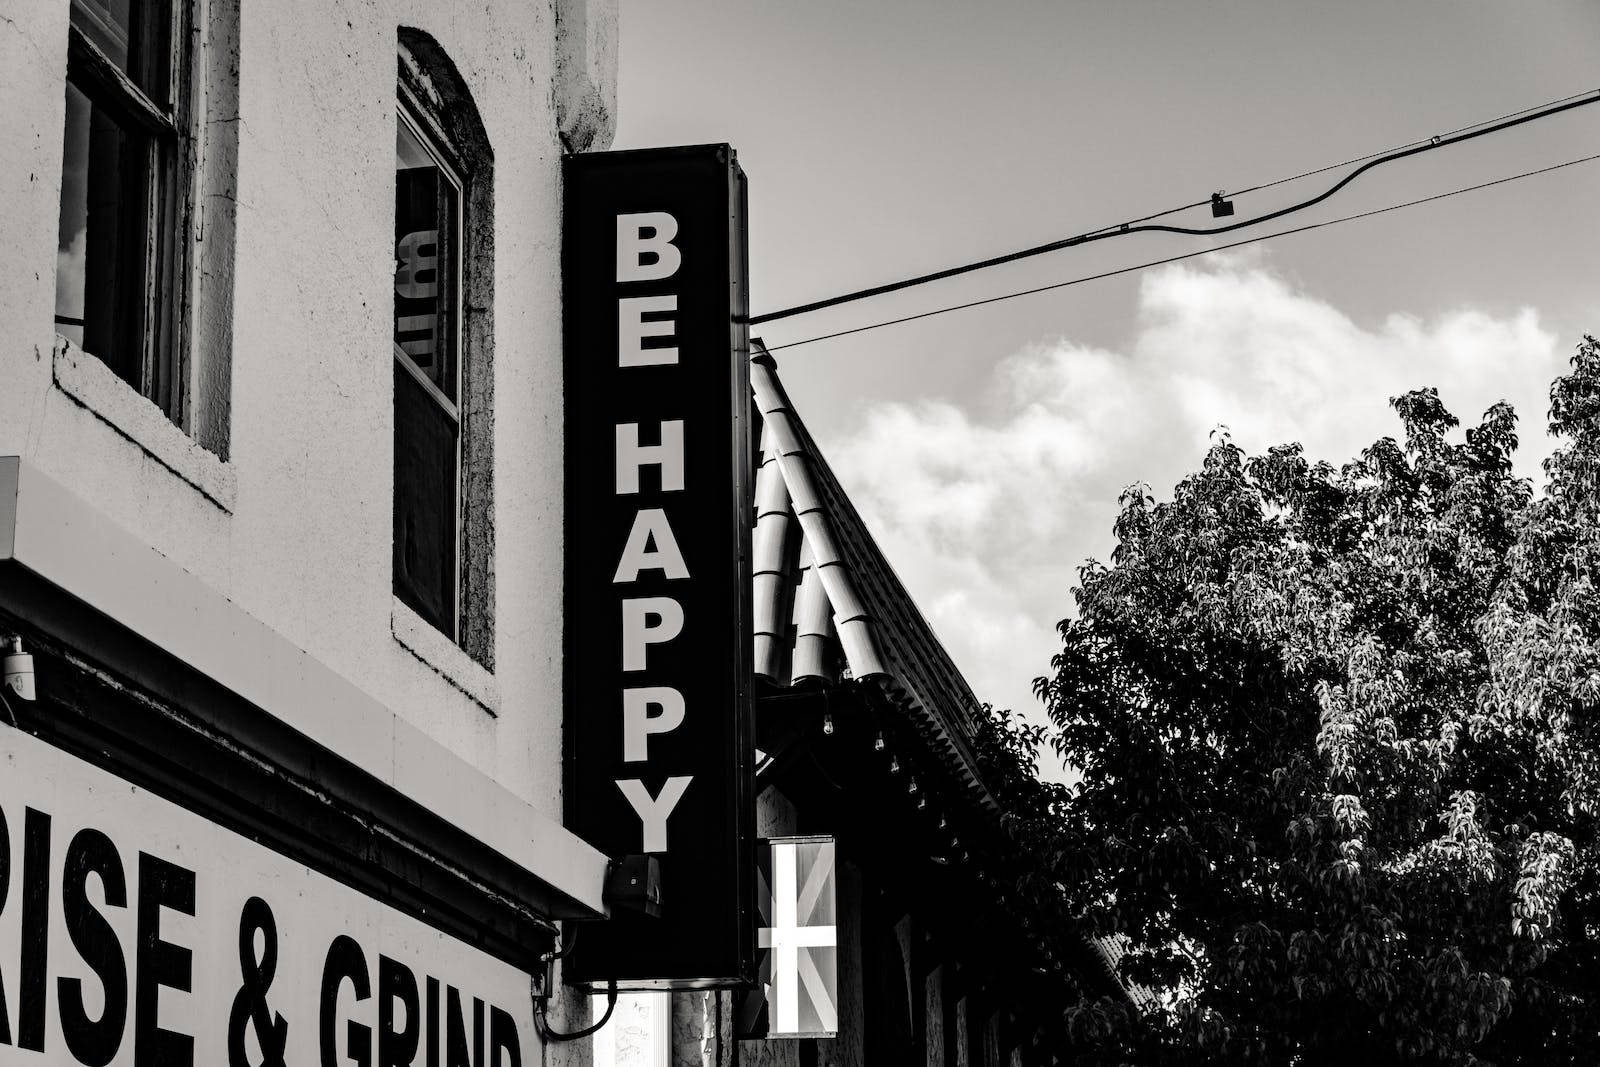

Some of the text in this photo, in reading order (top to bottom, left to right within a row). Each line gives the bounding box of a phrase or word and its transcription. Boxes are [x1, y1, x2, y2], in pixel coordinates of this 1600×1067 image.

[612, 211, 694, 853] BE HAPPY
[0, 803, 196, 1067] ISE
[228, 896, 288, 1067] &
